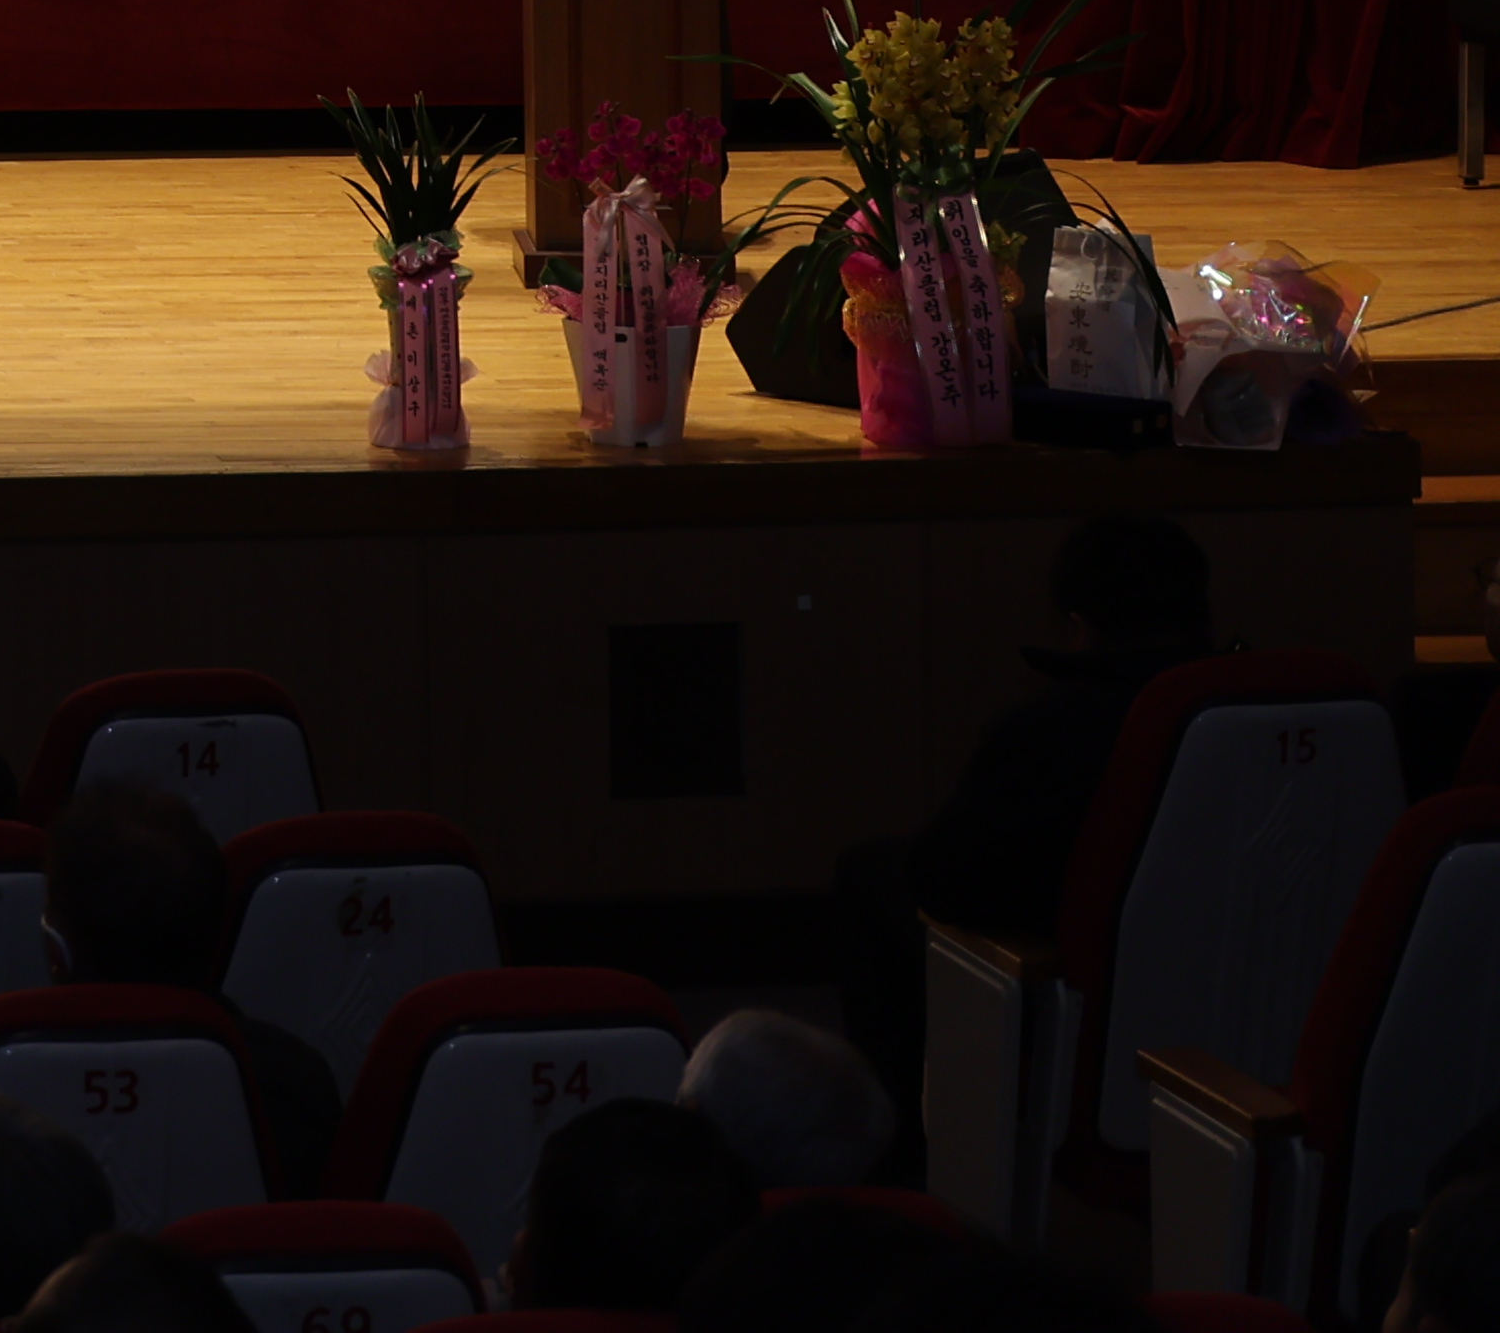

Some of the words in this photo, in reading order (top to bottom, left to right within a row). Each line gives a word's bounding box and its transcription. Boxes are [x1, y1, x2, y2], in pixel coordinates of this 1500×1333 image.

[968, 274, 999, 400] 축하합니다
[177, 741, 220, 777] 14
[1276, 727, 1317, 765] 15
[341, 895, 394, 936] 24
[84, 1069, 139, 1114] 53
[532, 1061, 593, 1106] 54
